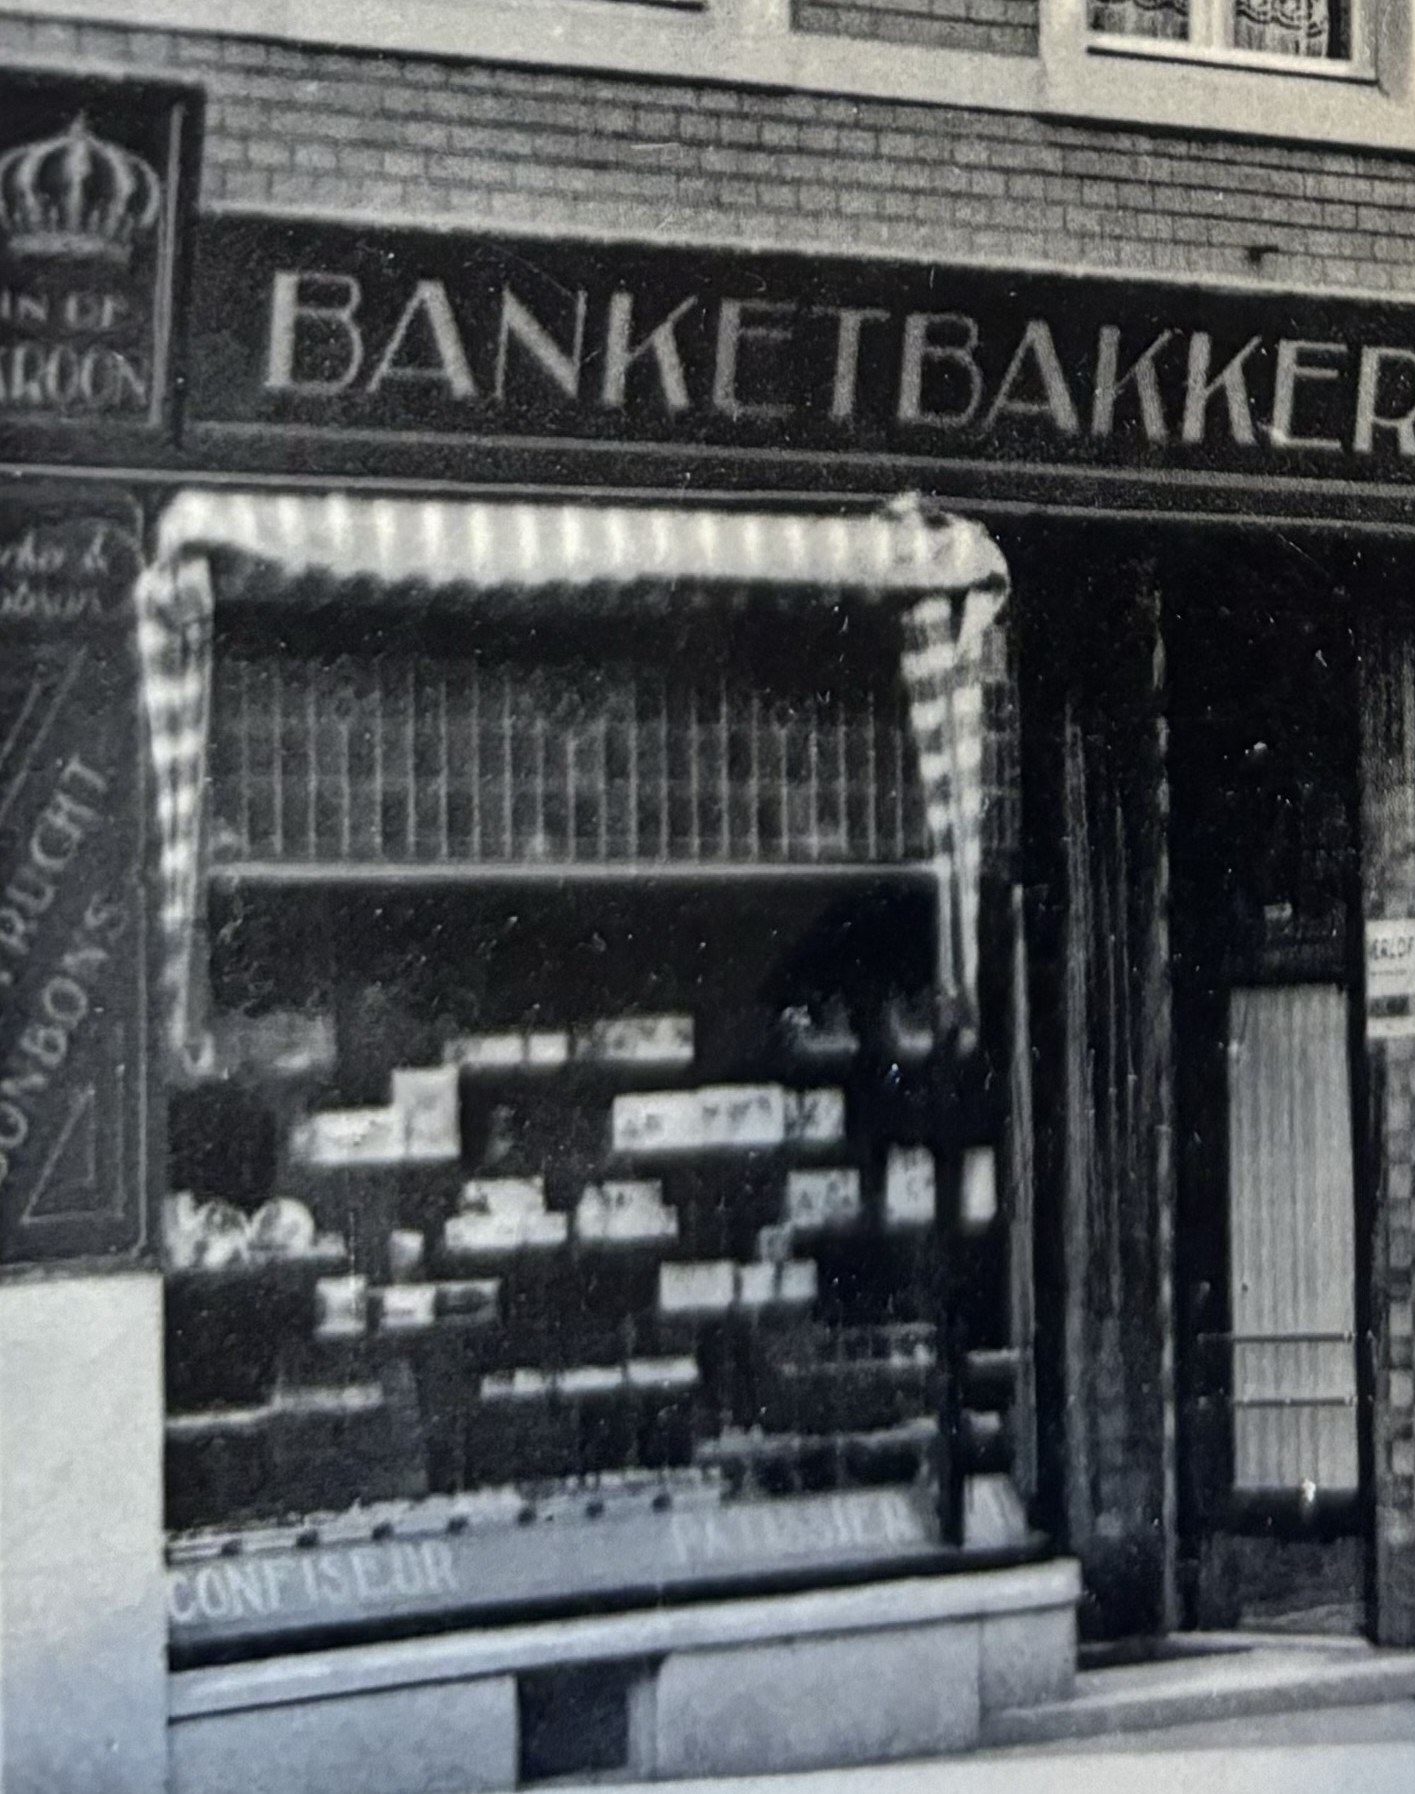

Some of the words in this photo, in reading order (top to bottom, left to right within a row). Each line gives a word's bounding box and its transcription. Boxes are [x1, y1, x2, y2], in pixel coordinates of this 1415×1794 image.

[0, 345, 148, 405] ROON
[0, 890, 132, 1185] ONBONS
[167, 1540, 458, 1623] CONFISEUR
